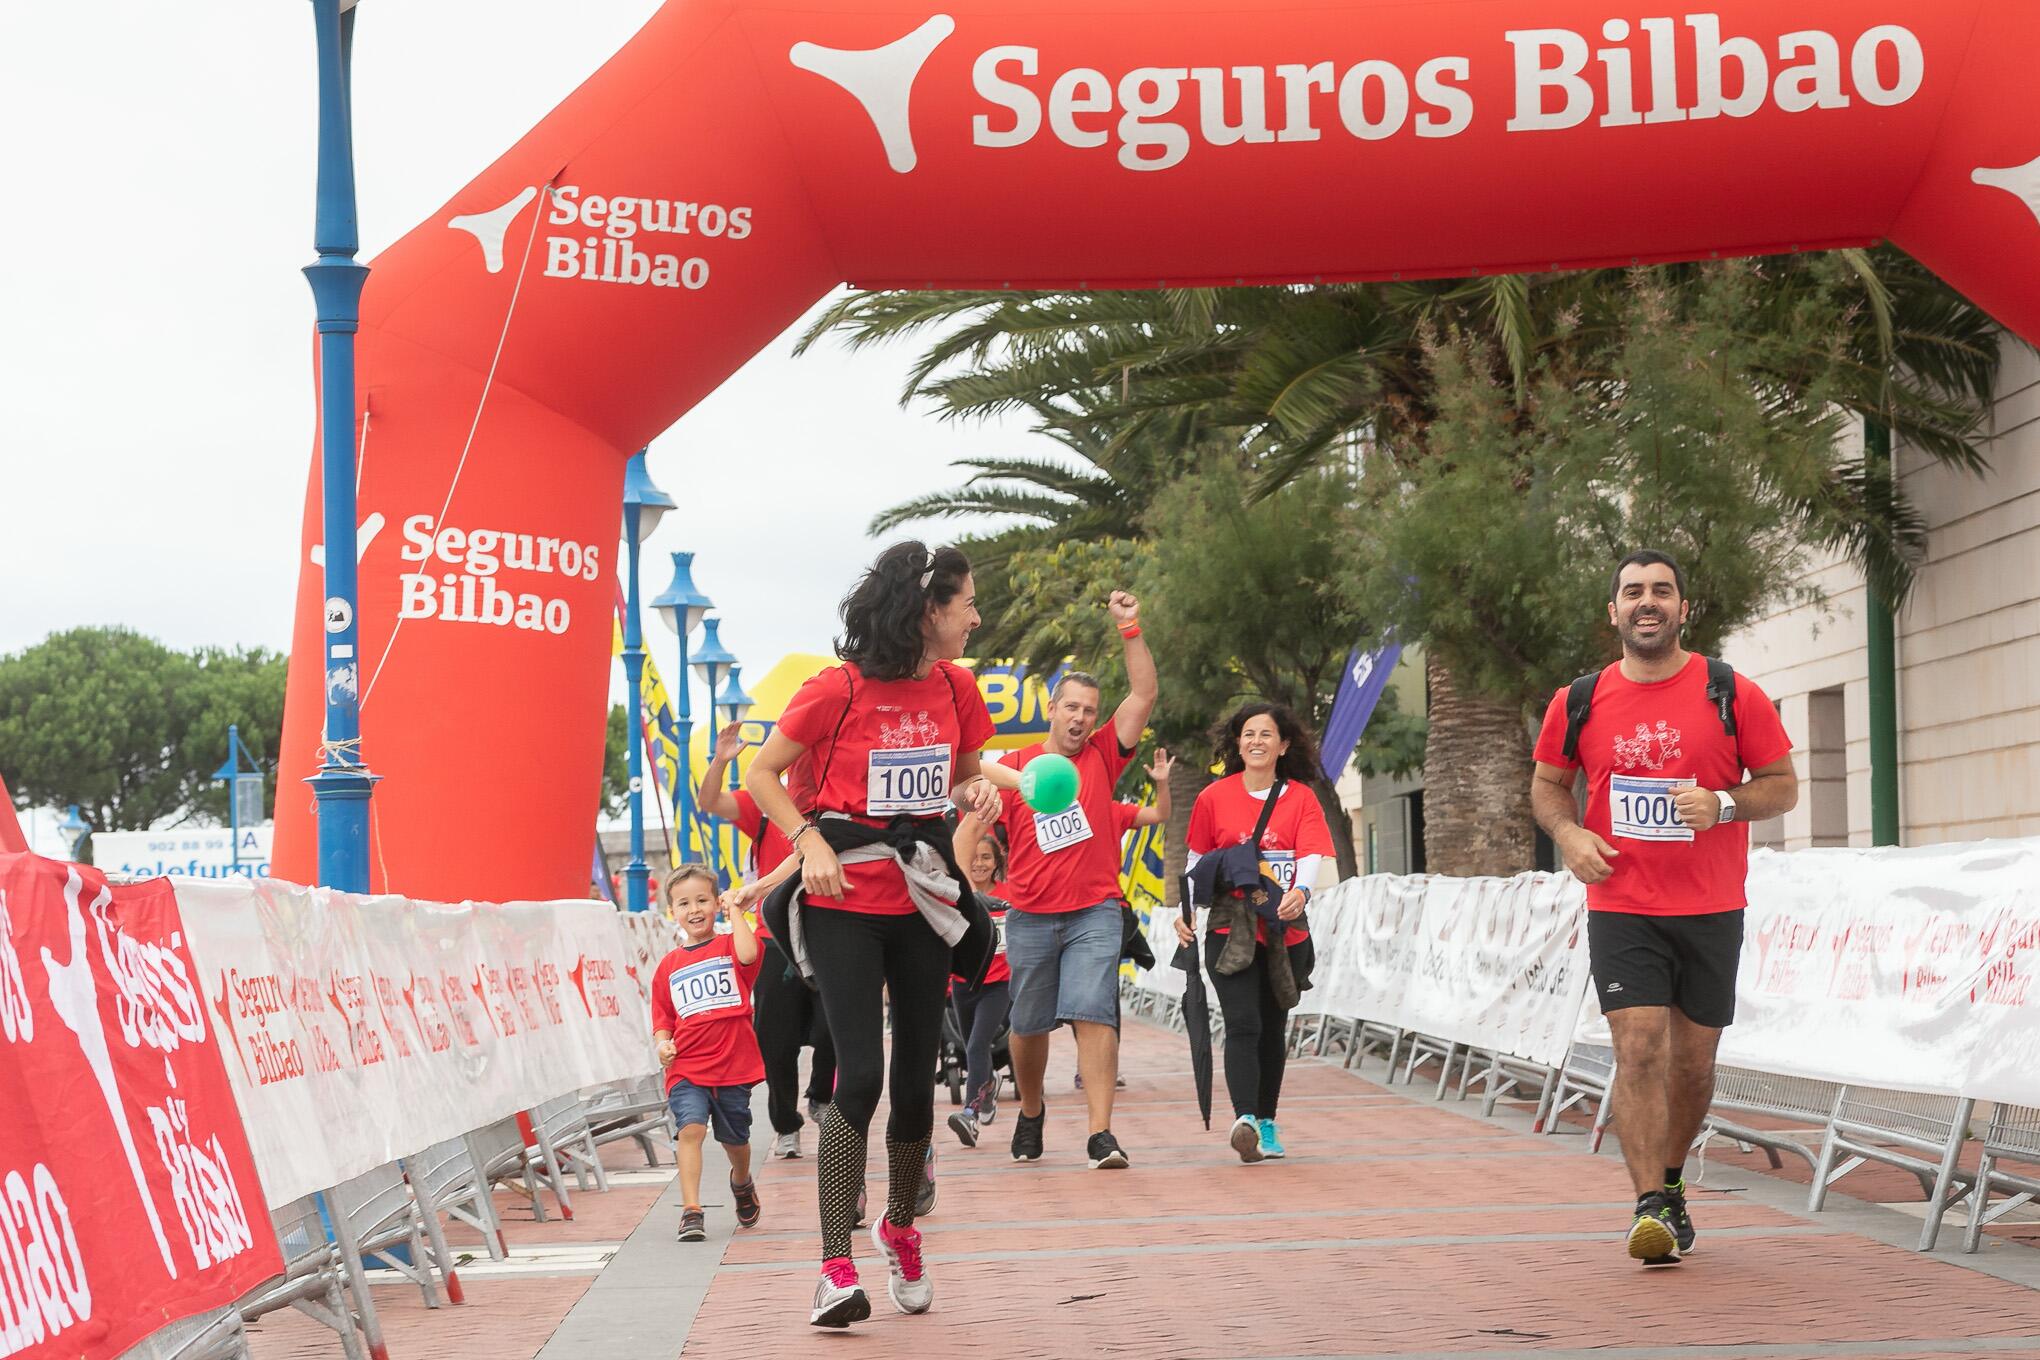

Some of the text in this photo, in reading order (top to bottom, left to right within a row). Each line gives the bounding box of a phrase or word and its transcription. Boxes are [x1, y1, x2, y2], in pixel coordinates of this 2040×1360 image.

[973, 14, 1924, 171] Seguros Bilbao
[548, 185, 752, 239] Seguros
[543, 236, 710, 290] Bilbao
[401, 514, 599, 581] Seguros
[397, 573, 571, 635] Bilbao
[880, 764, 943, 799] 1006
[1041, 811, 1083, 841] 1006
[677, 970, 732, 1005] 1005
